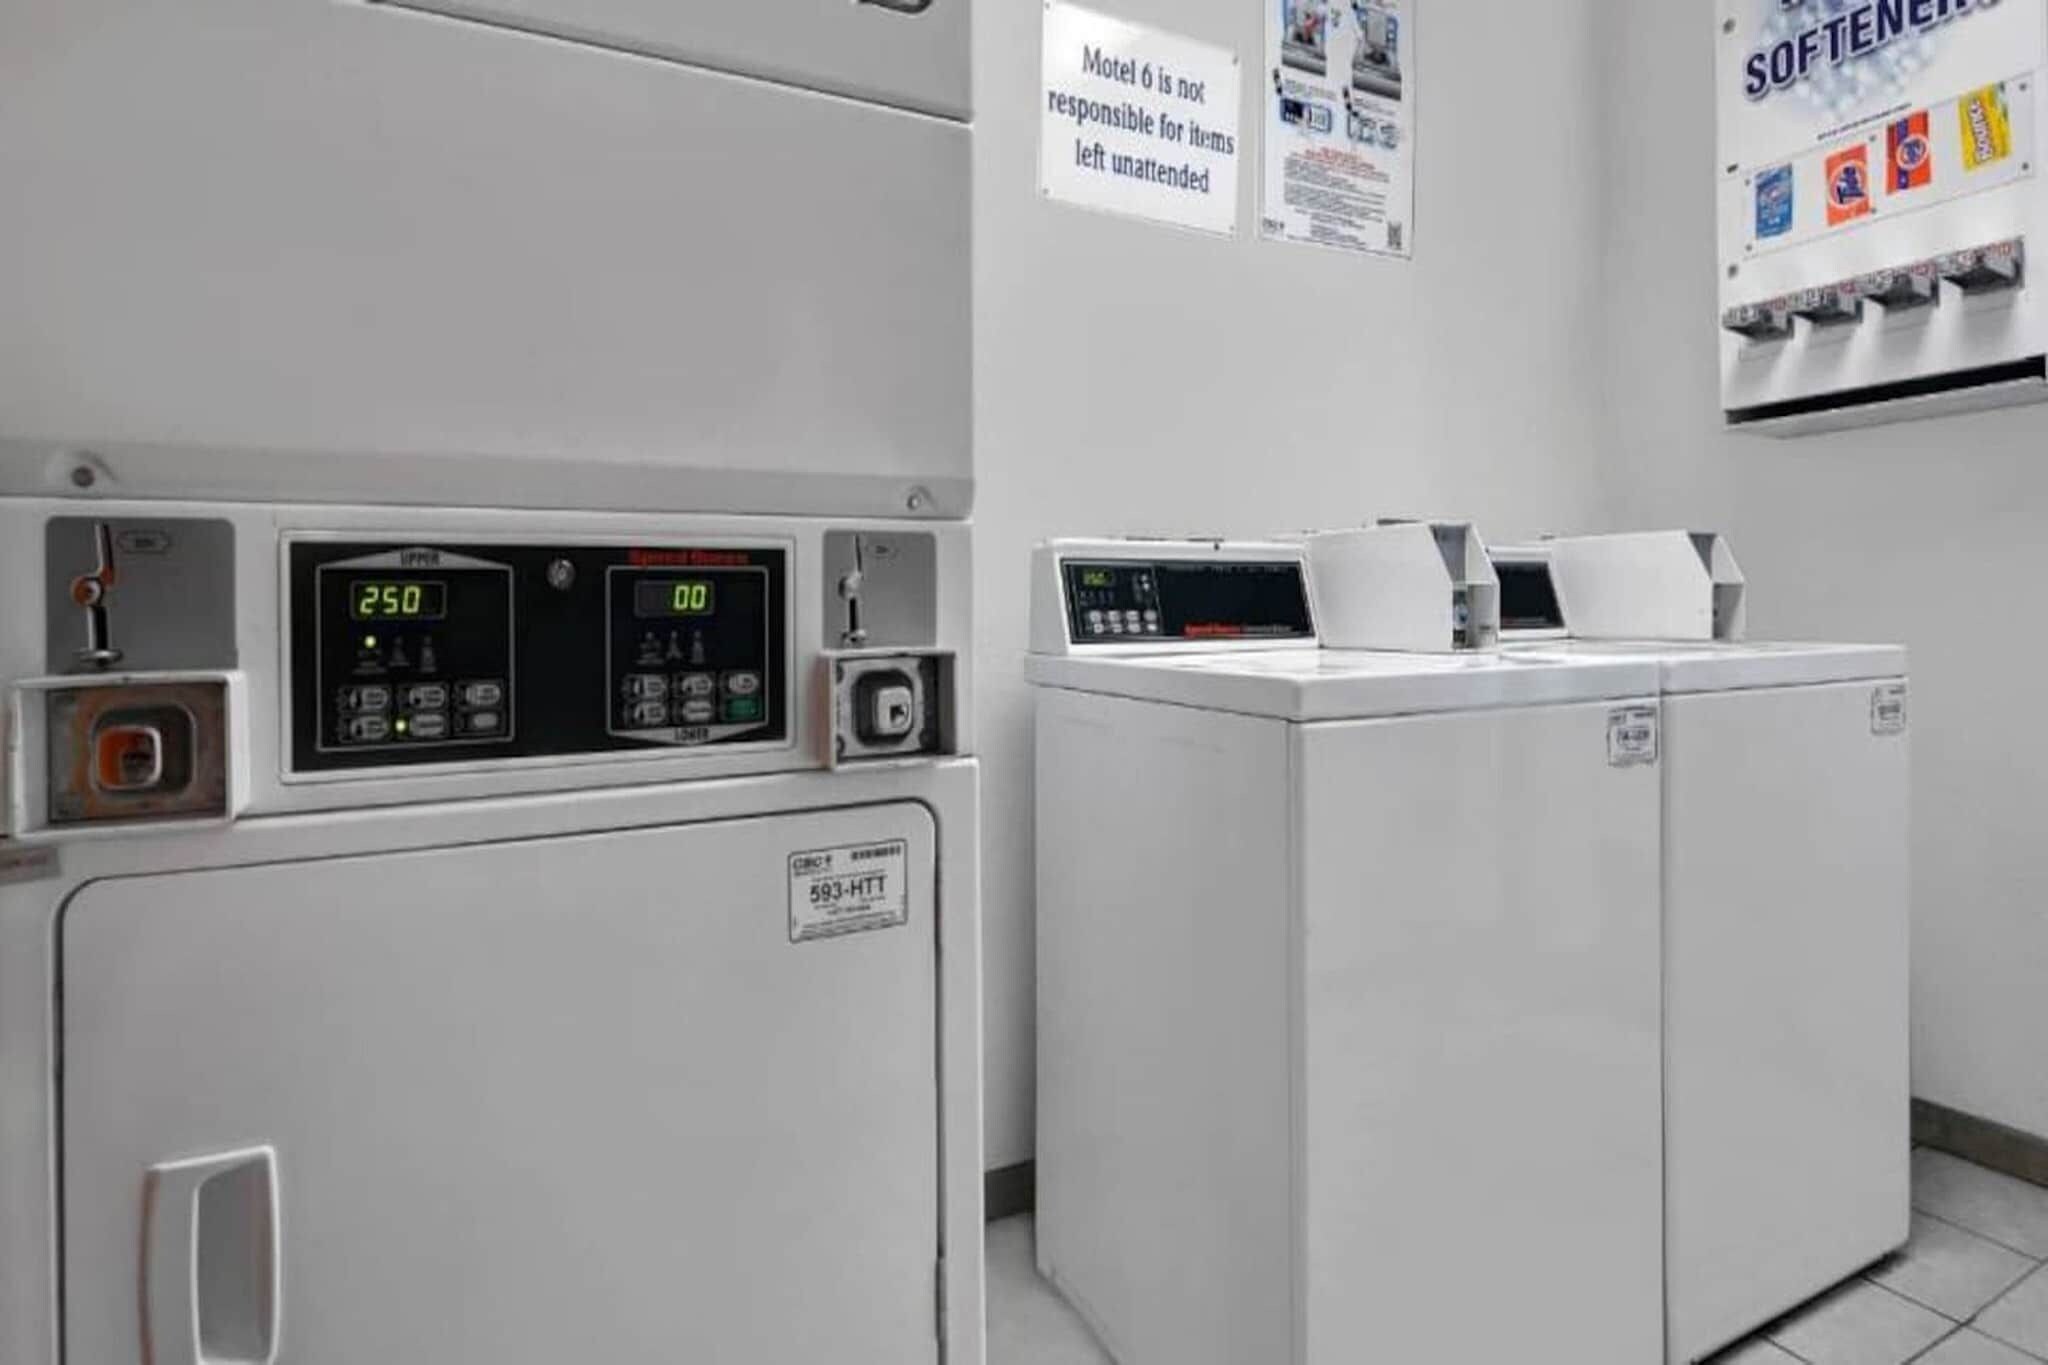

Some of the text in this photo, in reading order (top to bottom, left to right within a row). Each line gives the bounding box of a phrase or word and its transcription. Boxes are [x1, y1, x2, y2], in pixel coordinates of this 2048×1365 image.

[1082, 44, 1206, 105] Motel 6 is not
[1048, 90, 1235, 155] responsible for items
[1075, 138, 1210, 193] left unattended
[359, 586, 422, 614] 250
[673, 584, 707, 611] 00
[809, 876, 885, 904] 593-HTT
